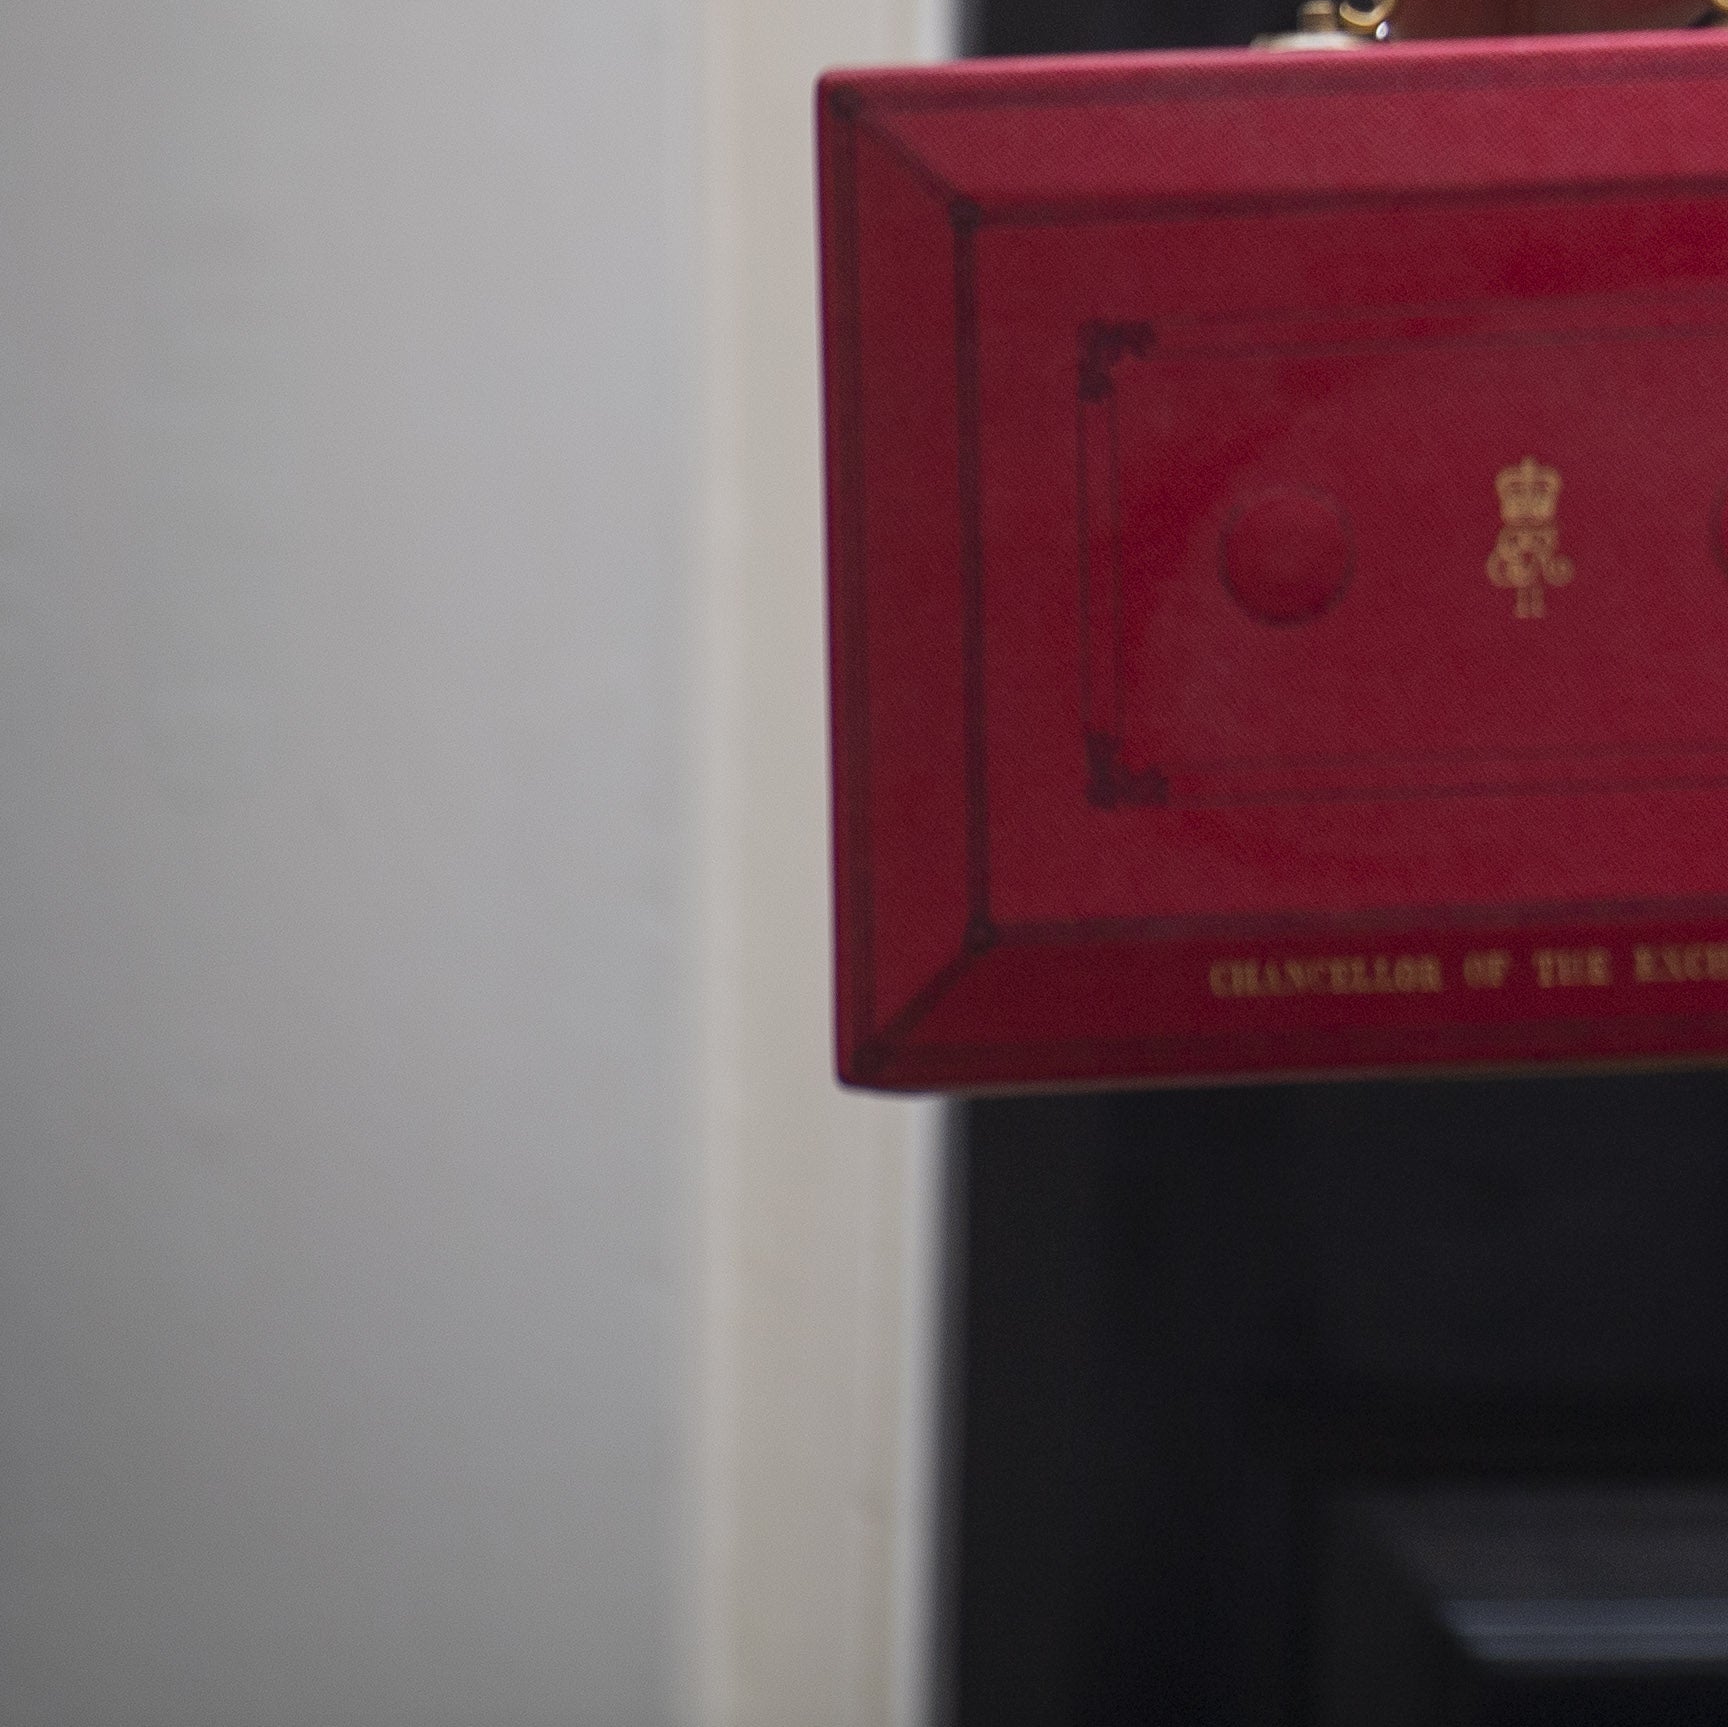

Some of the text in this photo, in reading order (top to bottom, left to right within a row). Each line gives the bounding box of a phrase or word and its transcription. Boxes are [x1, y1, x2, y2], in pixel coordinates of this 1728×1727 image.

[1209, 955, 1442, 997] CHANCELLOR
[1462, 949, 1512, 990] OF
[1532, 946, 1614, 989] THE
